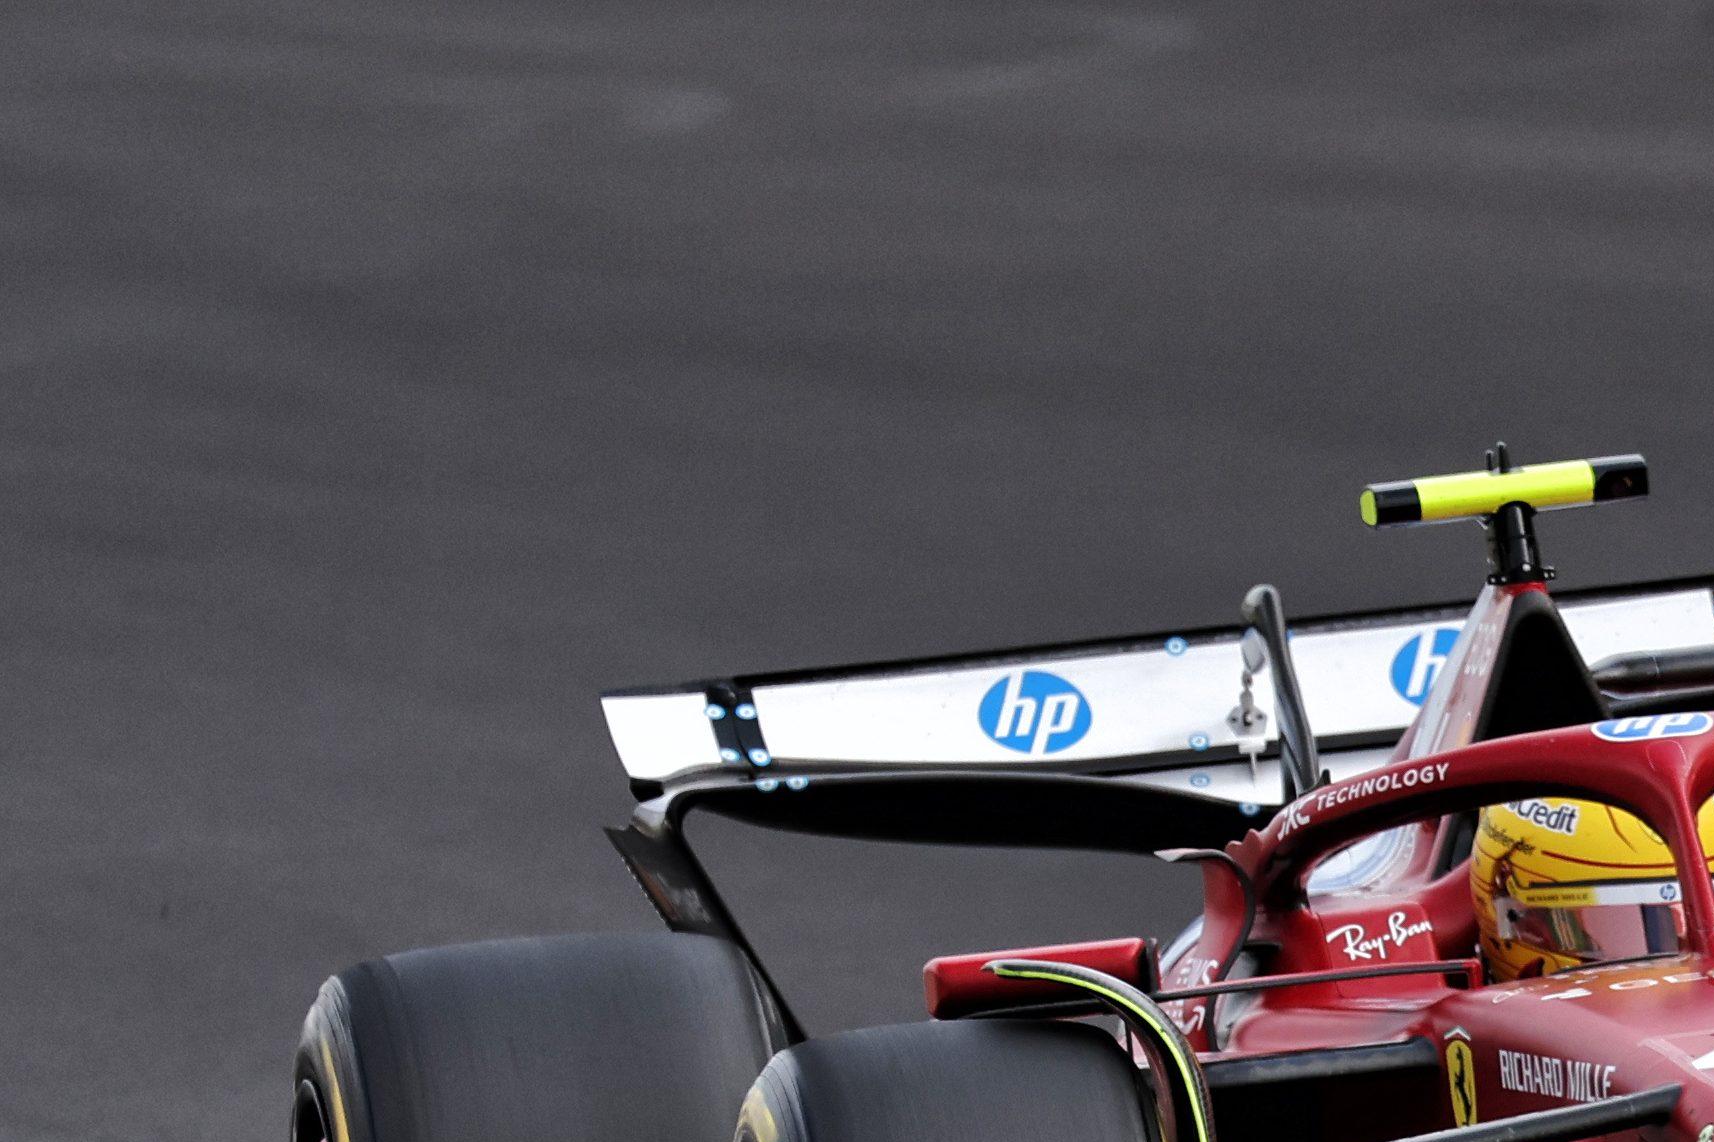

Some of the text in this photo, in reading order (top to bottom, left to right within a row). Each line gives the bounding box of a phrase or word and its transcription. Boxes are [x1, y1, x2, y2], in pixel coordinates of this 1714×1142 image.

[993, 671, 1081, 755] hp
[1315, 761, 1450, 813] TECHNOLOGY
[1507, 801, 1577, 834] Credit
[1325, 910, 1434, 961] Ray-Ban
[1498, 1049, 1617, 1103] RICHARD MILLE
